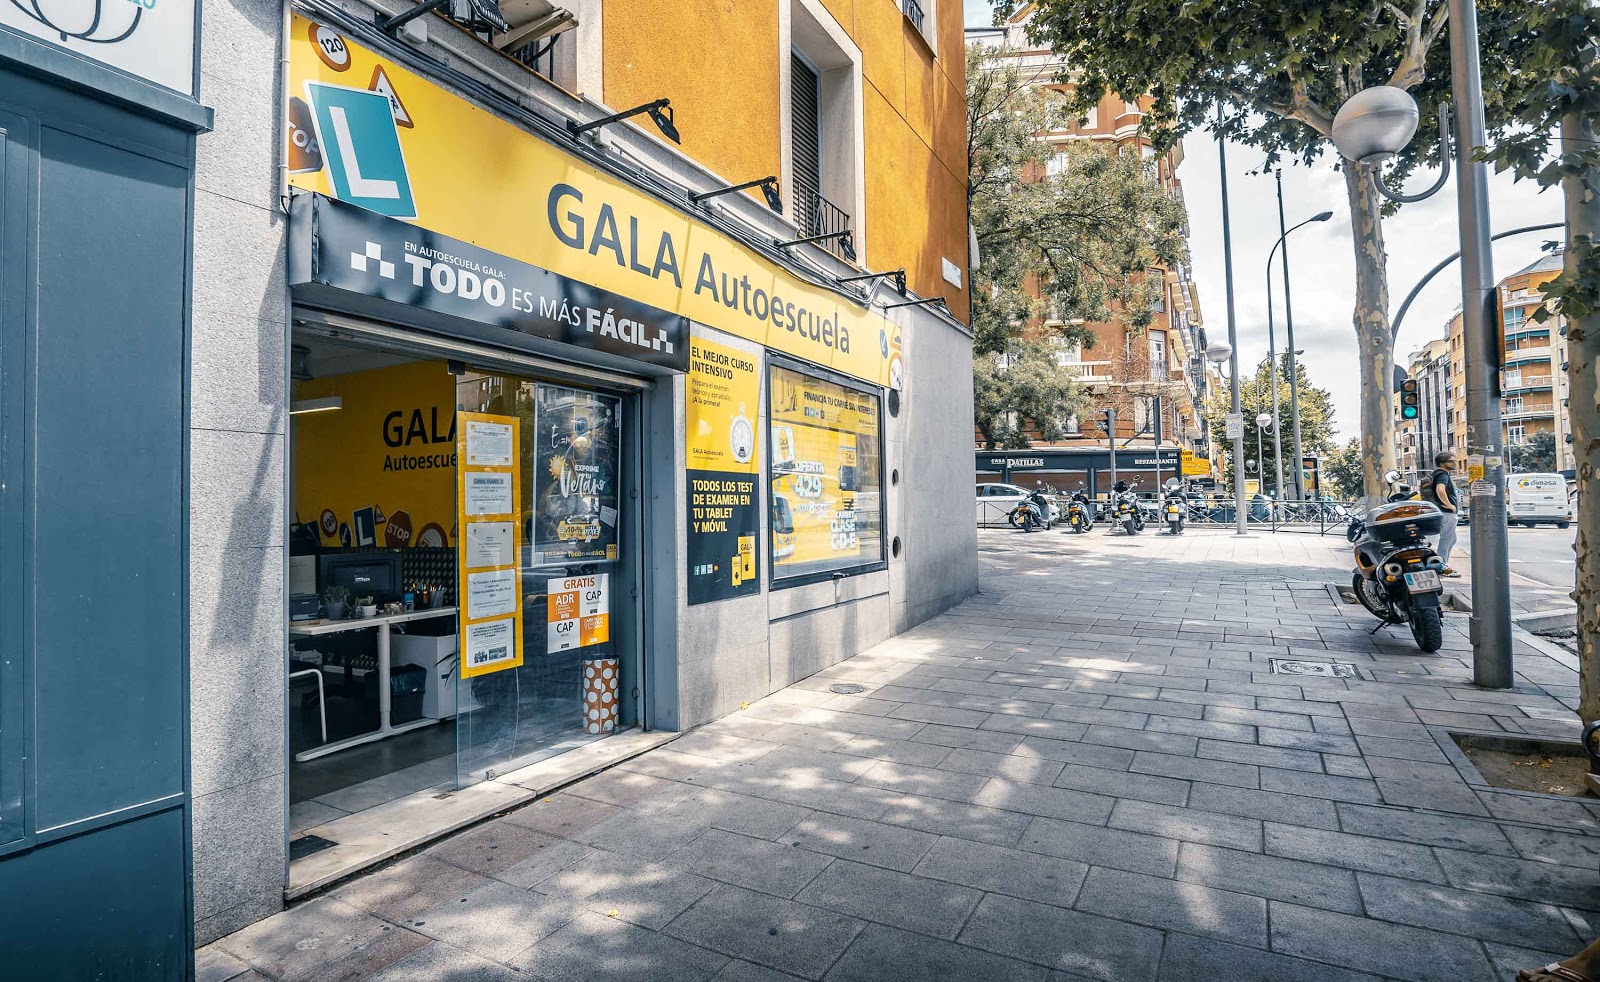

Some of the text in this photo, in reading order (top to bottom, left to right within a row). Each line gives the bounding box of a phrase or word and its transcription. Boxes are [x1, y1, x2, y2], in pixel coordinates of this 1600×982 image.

[321, 38, 343, 54] 120
[289, 120, 319, 154] OP
[328, 106, 400, 199] L
[404, 240, 506, 280] EN AUTOESCUELA GALA:
[547, 183, 850, 354] GALA Autoescuela
[404, 252, 651, 348] TODO ES MÁS FÁCIL
[692, 346, 754, 373] EL MEJOR CURSO
[692, 360, 733, 380] INTENSIVO
[692, 378, 708, 389] Prepara
[804, 391, 826, 404] FINANCIA
[827, 397, 833, 405] TU
[575, 464, 600, 472] EXPRIME
[795, 461, 825, 473] OFERTA
[1007, 458, 1044, 468] PATILLAS
[693, 480, 753, 493] TODOS LOS TEST
[693, 494, 750, 505] DE EXAMEN EN
[693, 508, 733, 519] TU TABLET
[325, 516, 335, 528] 120
[694, 519, 728, 533] Y MÓVIL
[830, 519, 856, 532] CLASE
[357, 516, 373, 546] L
[387, 523, 410, 542] STOP
[564, 577, 595, 590] GRATIS
[556, 593, 574, 605] ADR
[586, 590, 602, 601] CAP
[556, 622, 574, 633] CAP
